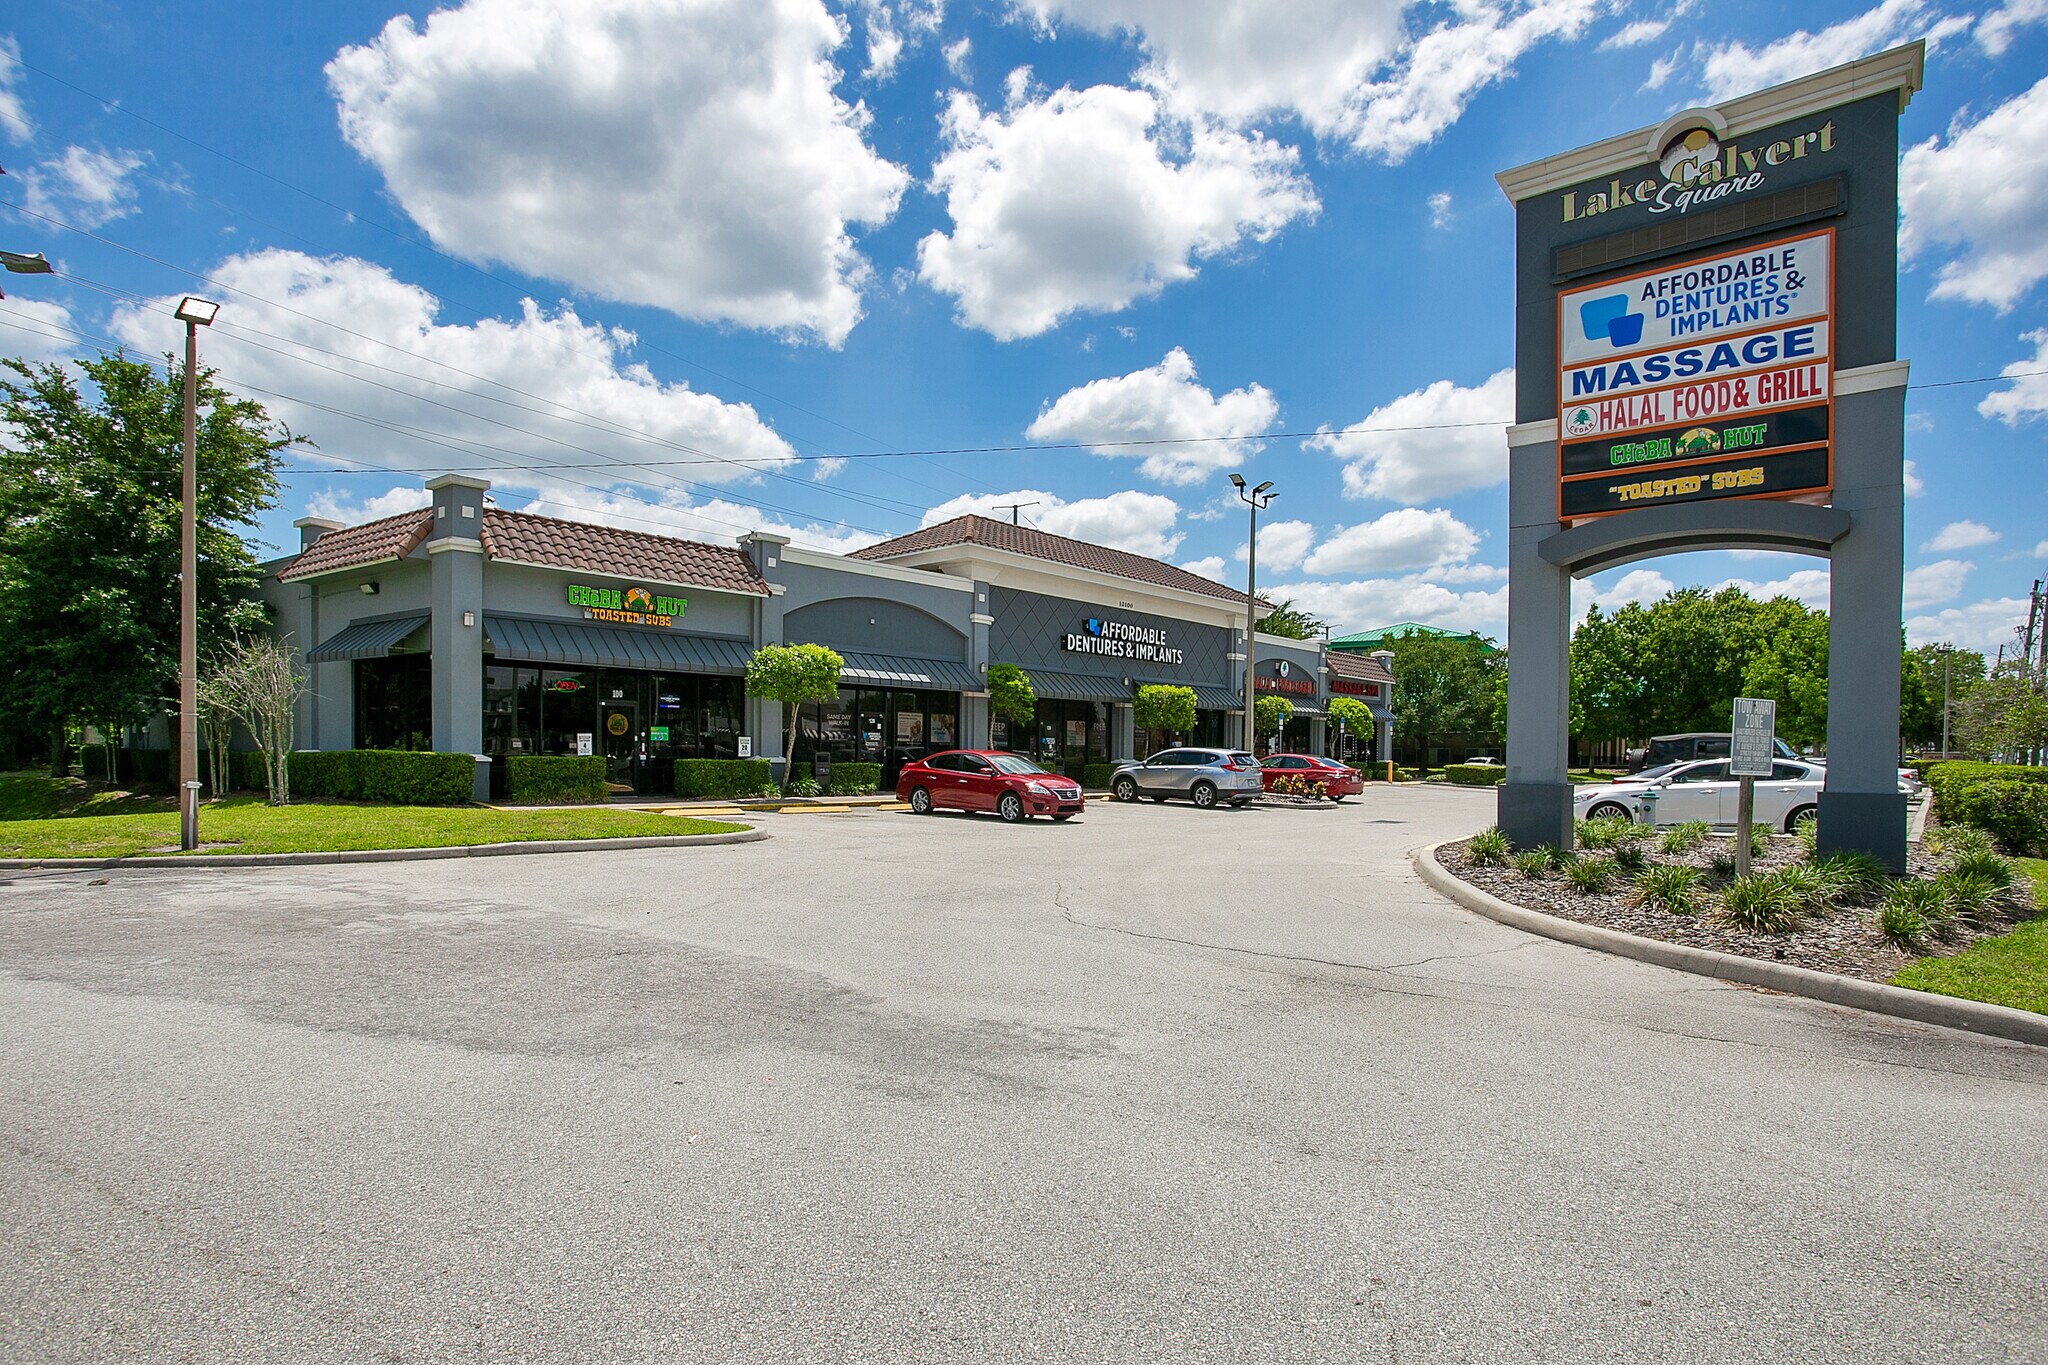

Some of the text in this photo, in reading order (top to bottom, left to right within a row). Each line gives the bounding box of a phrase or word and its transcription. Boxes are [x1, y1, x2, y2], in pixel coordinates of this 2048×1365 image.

[1560, 118, 1838, 225] Lake Calvert
[1647, 169, 1767, 215] Square
[1640, 248, 1797, 302] AFFORDABLE
[1655, 269, 1807, 320] DENTURES &
[1572, 327, 1815, 396] MASSAGE
[1599, 392, 1666, 432] HALAL
[1757, 366, 1823, 404] GRILL
[1569, 422, 1594, 433] CEDAR
[1723, 423, 1768, 450] HUT
[1711, 467, 1765, 490] SUBS
[656, 595, 688, 617] HUT
[645, 613, 673, 627] SUBS
[1100, 621, 1167, 646] AFFORDABLE
[1067, 633, 1183, 665] DENTURES & IMPLANTS
[556, 680, 578, 690] OPEN
[612, 689, 624, 698] 100
[1745, 714, 1764, 728] ZONE
